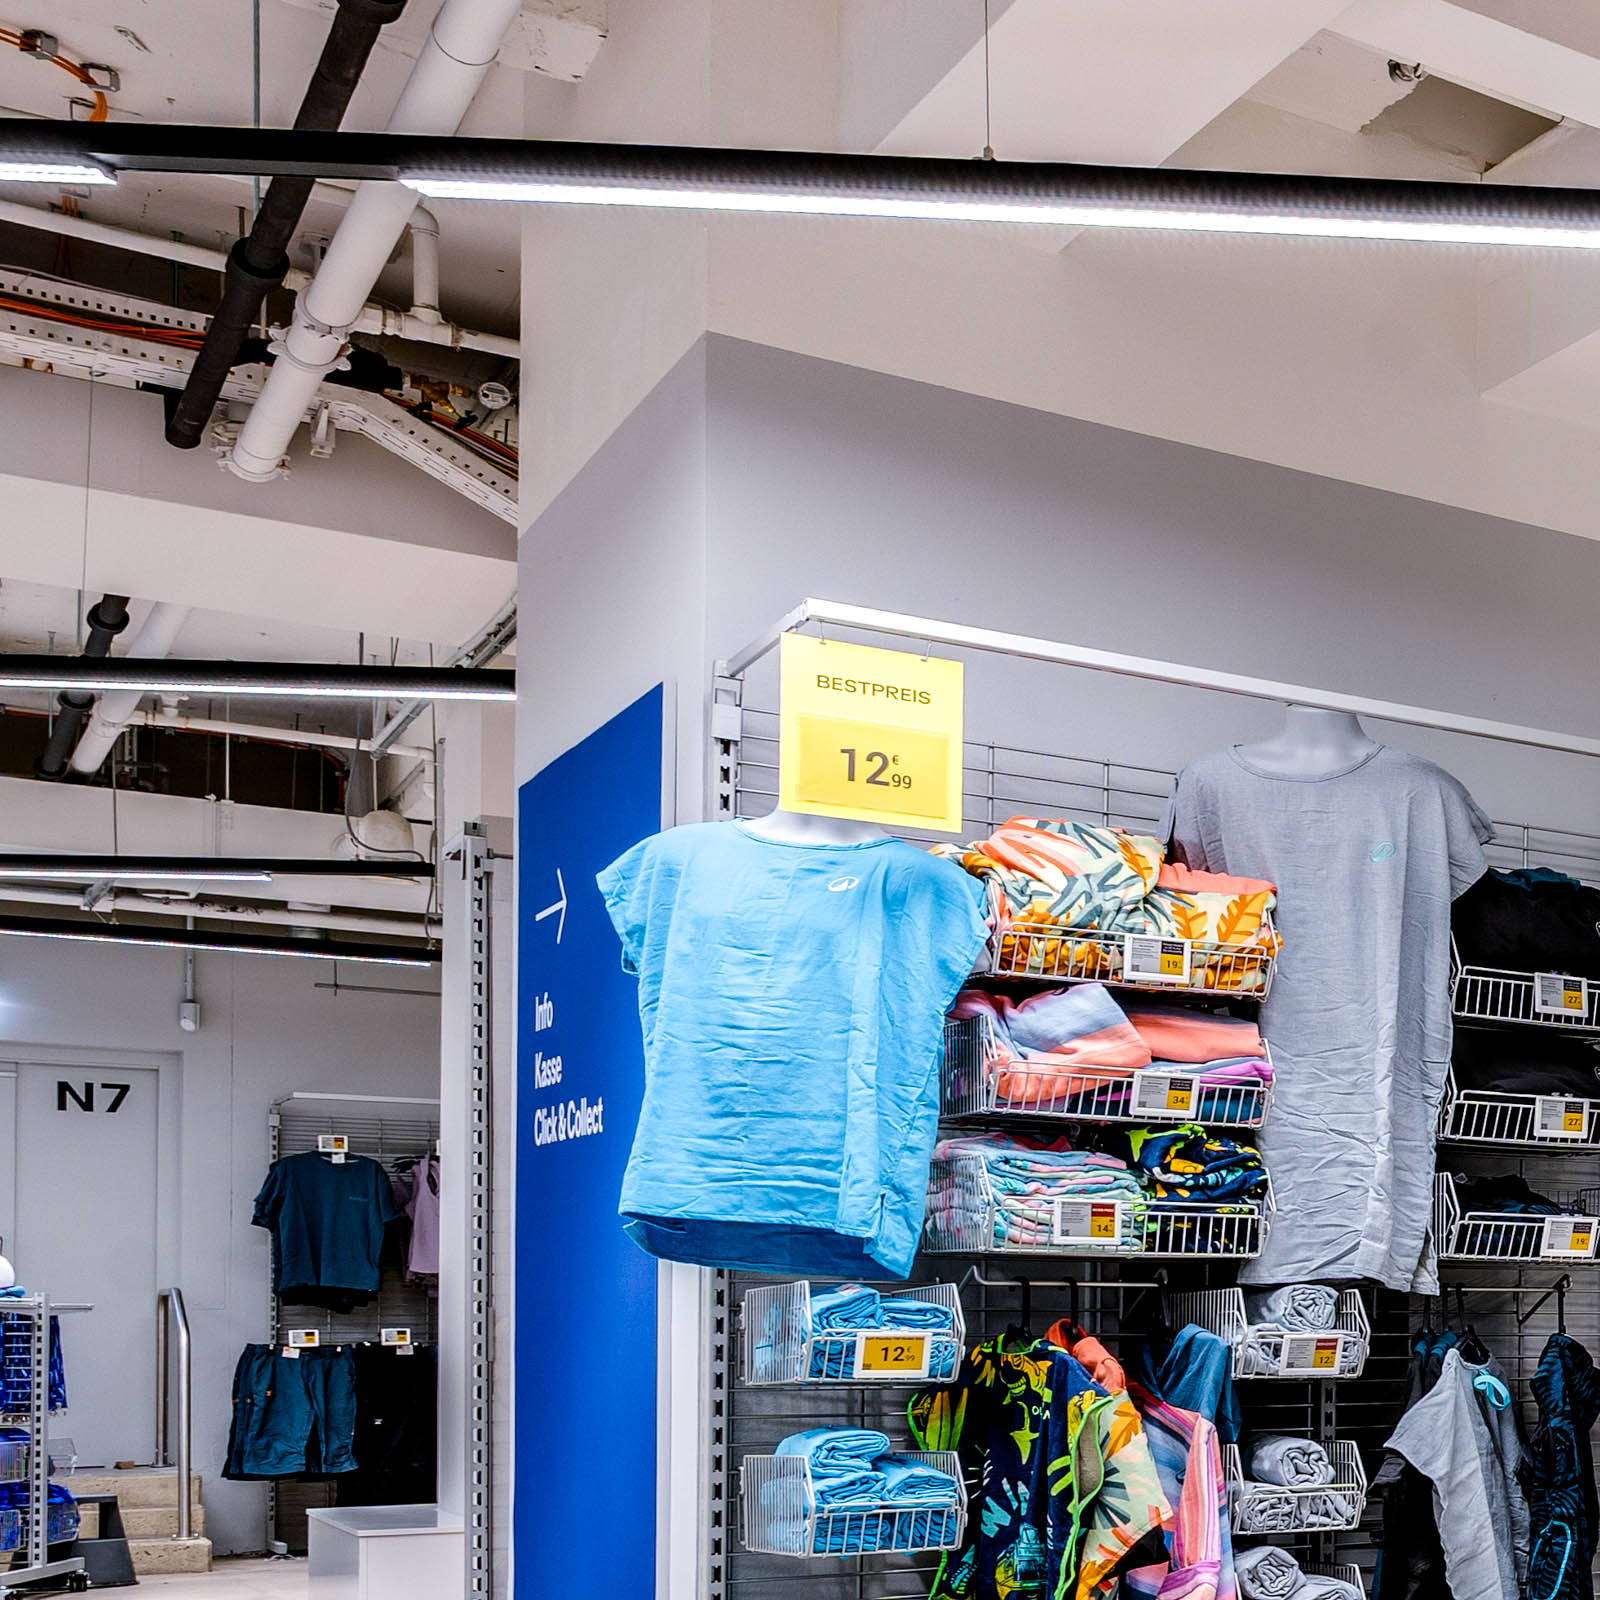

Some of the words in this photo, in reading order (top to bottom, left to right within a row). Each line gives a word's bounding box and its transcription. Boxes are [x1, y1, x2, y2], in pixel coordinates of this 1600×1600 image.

[816, 674, 931, 705] BESTPREIS
[535, 991, 554, 1032] Info
[534, 1052, 563, 1089] Kasse
[57, 1081, 131, 1112] N7
[534, 1105, 558, 1147] Click
[558, 1102, 567, 1142] &
[566, 1096, 603, 1140] Collect
